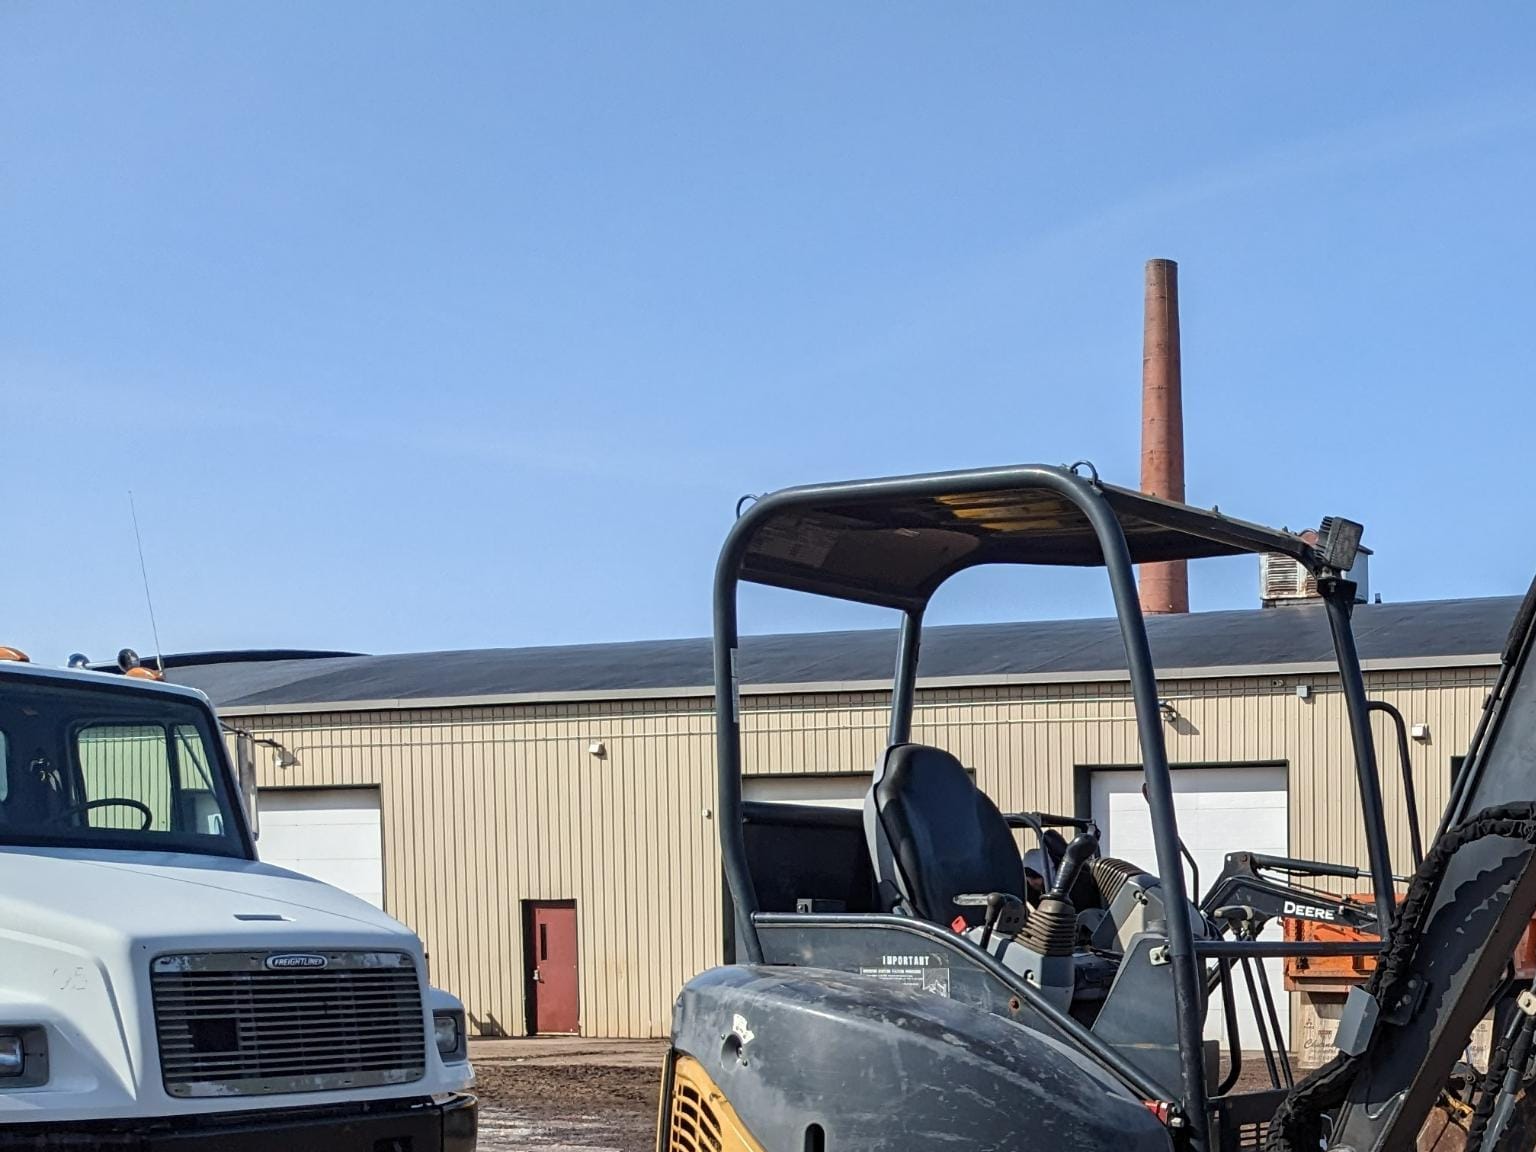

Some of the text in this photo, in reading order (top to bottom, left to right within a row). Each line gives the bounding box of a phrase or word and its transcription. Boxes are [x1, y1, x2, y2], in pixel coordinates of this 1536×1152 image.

[1283, 901, 1335, 920] DEERE
[274, 957, 323, 966] FREIGHTLINER
[882, 955, 930, 966] IMPORTANT
